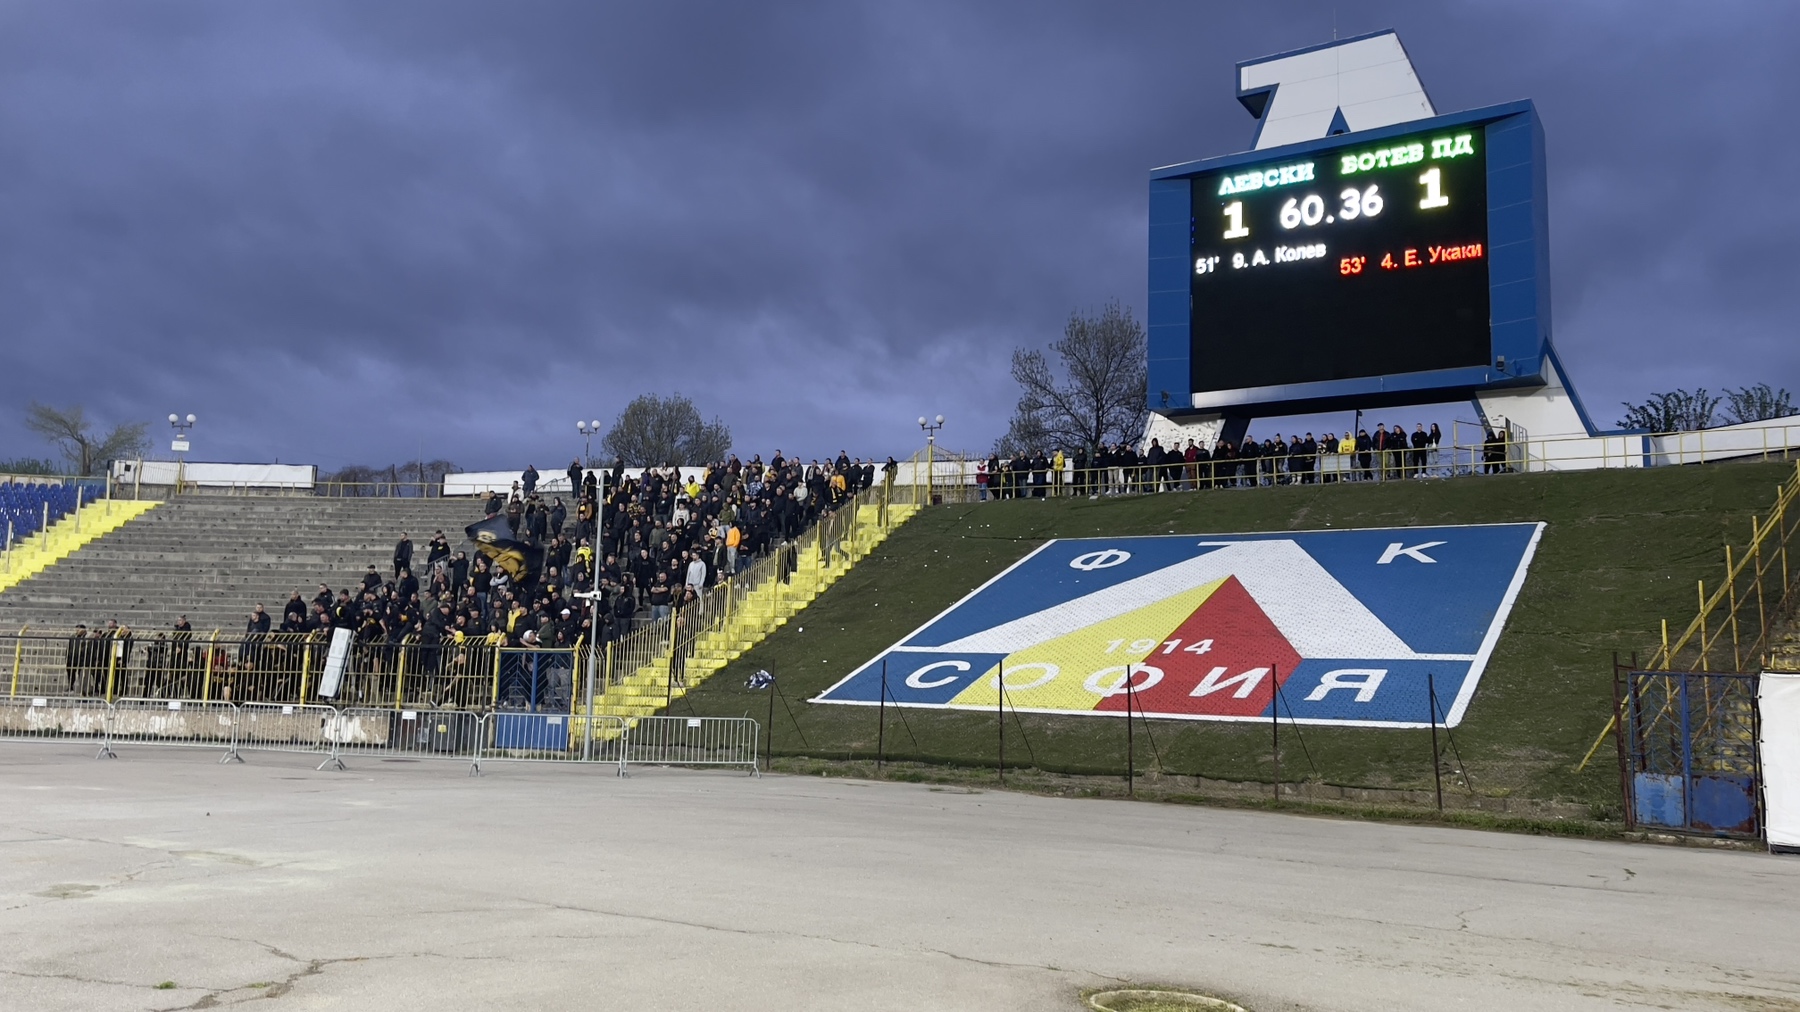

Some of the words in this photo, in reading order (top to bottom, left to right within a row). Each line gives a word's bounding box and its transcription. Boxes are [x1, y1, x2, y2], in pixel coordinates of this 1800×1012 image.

[1218, 162, 1315, 196] ЛЕВСКИ
[1341, 143, 1424, 175] БОТЕВ
[1431, 134, 1474, 159] ПД
[1223, 201, 1250, 239] 1
[1280, 184, 1384, 229] 60.36
[1419, 168, 1449, 209] 1
[1232, 252, 1249, 269] 9.
[1275, 243, 1327, 263] Колев
[1340, 256, 1366, 274] 53'
[1381, 253, 1398, 269] 4.
[1428, 243, 1482, 263] Укаки
[1105, 638, 1214, 655] 1914
